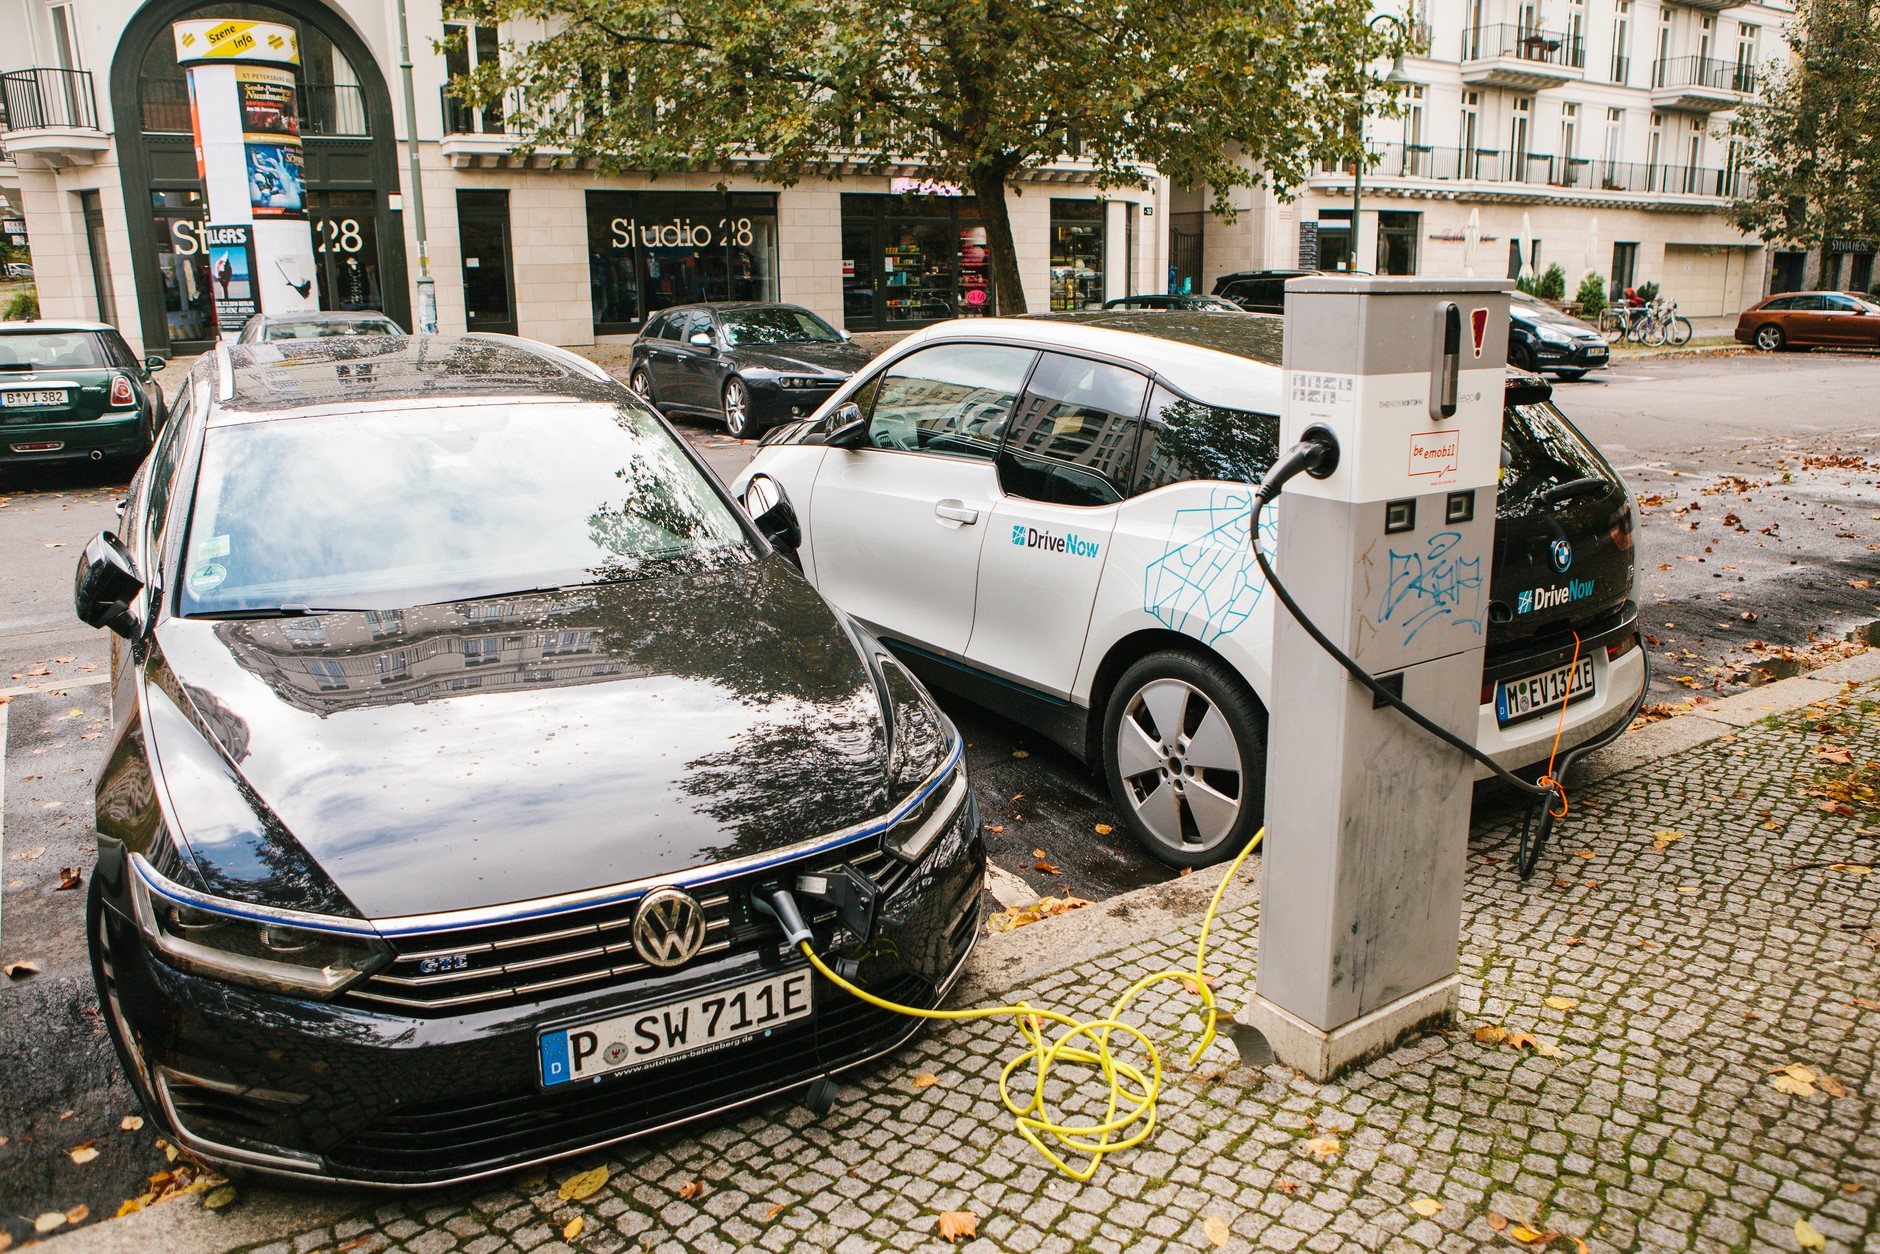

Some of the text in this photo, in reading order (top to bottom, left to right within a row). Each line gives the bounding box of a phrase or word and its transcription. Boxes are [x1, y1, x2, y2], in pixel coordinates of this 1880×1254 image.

[208, 25, 237, 44] Szene
[233, 34, 253, 48] Info
[316, 219, 363, 253] 28
[611, 217, 753, 248] Studio 28
[7, 391, 64, 404] B YI 382
[1413, 444, 1456, 460] be emobil
[1027, 527, 1100, 559] DriveNow
[1533, 579, 1595, 611] DriveNow
[1507, 685, 1519, 715] M
[420, 955, 468, 973] GTE
[569, 975, 808, 1072] P SW 711E
[551, 1062, 562, 1074] D
[614, 1035, 754, 1078] www.autohaus-babelsberg.de
